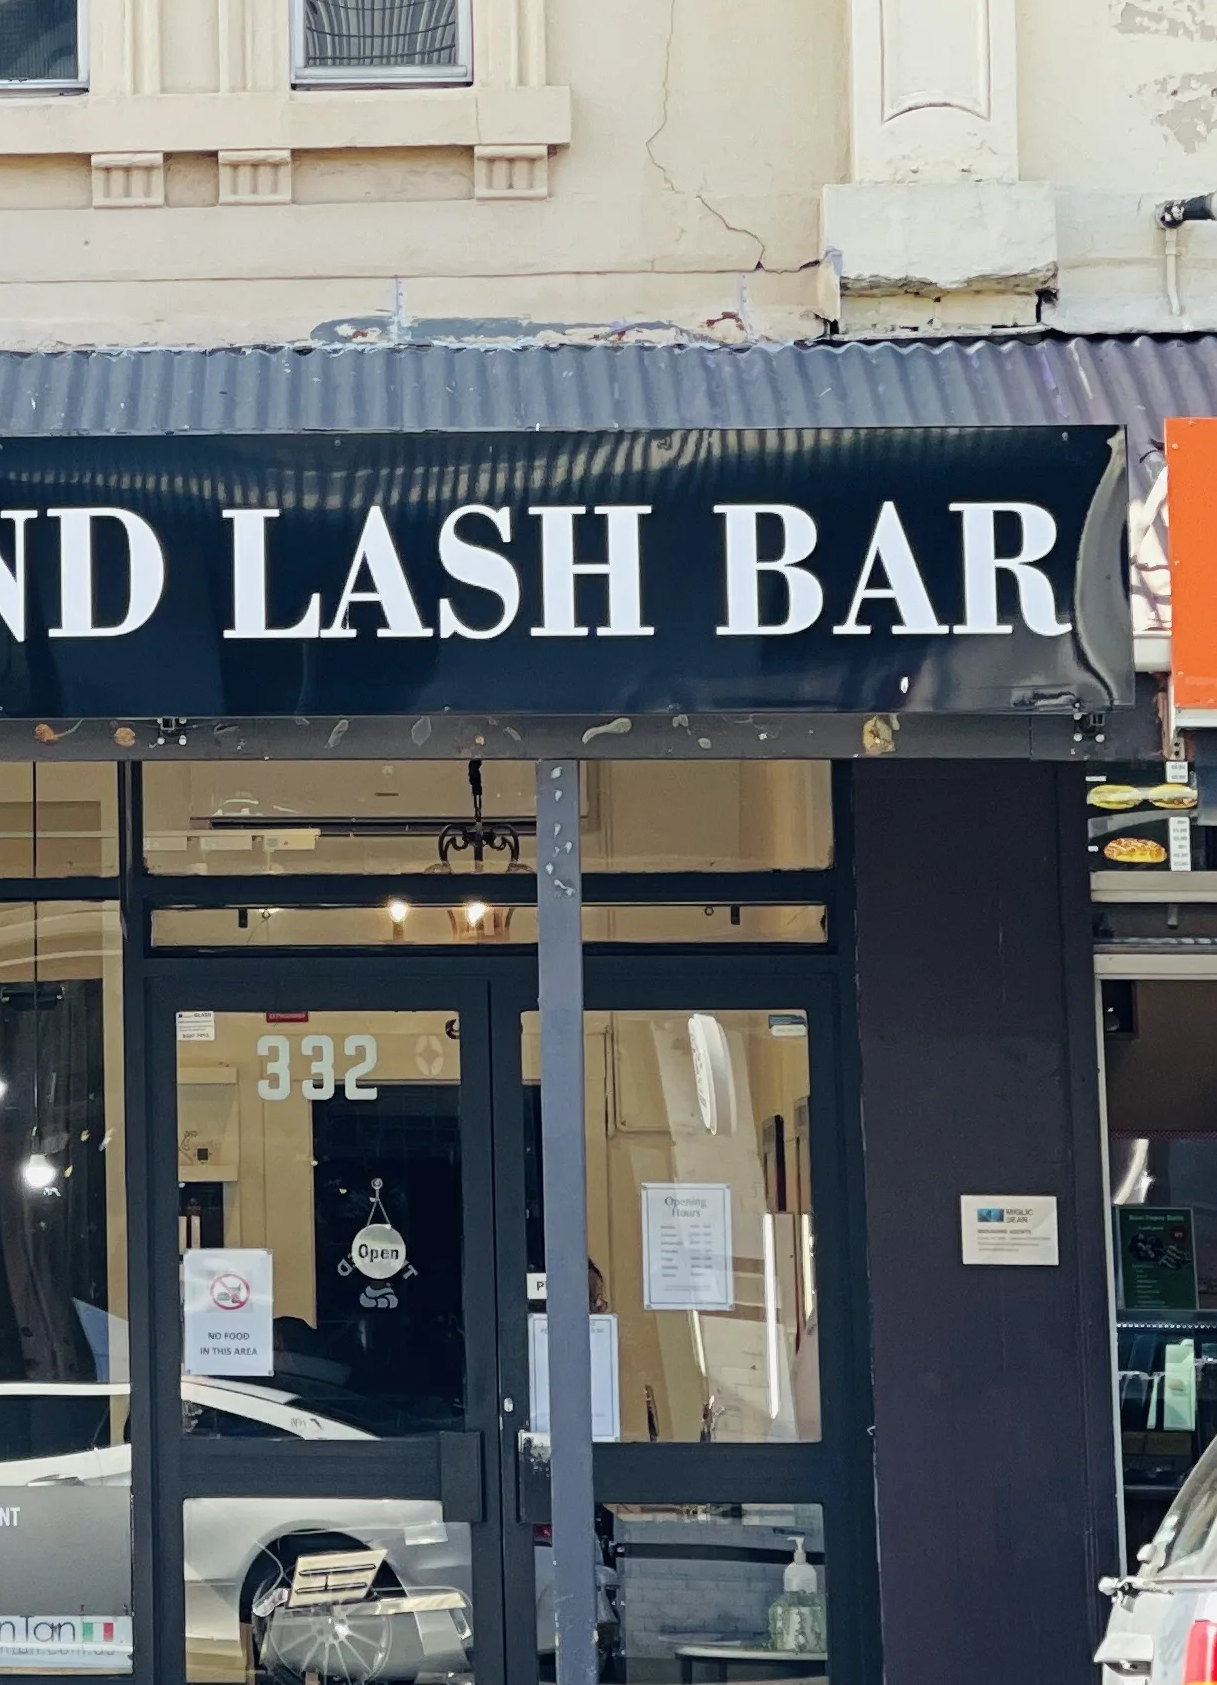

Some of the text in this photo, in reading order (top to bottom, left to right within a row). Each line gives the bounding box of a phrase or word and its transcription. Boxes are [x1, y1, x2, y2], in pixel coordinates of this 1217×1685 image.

[222, 503, 655, 641] LASH
[712, 500, 1074, 637] BAR
[257, 1035, 378, 1100] 332
[664, 1196, 707, 1209] Opening
[671, 1208, 701, 1217] Hours
[358, 1244, 399, 1262] Open
[208, 1332, 250, 1340] NO FOOD
[200, 1347, 258, 1355] IN THIS AREA
